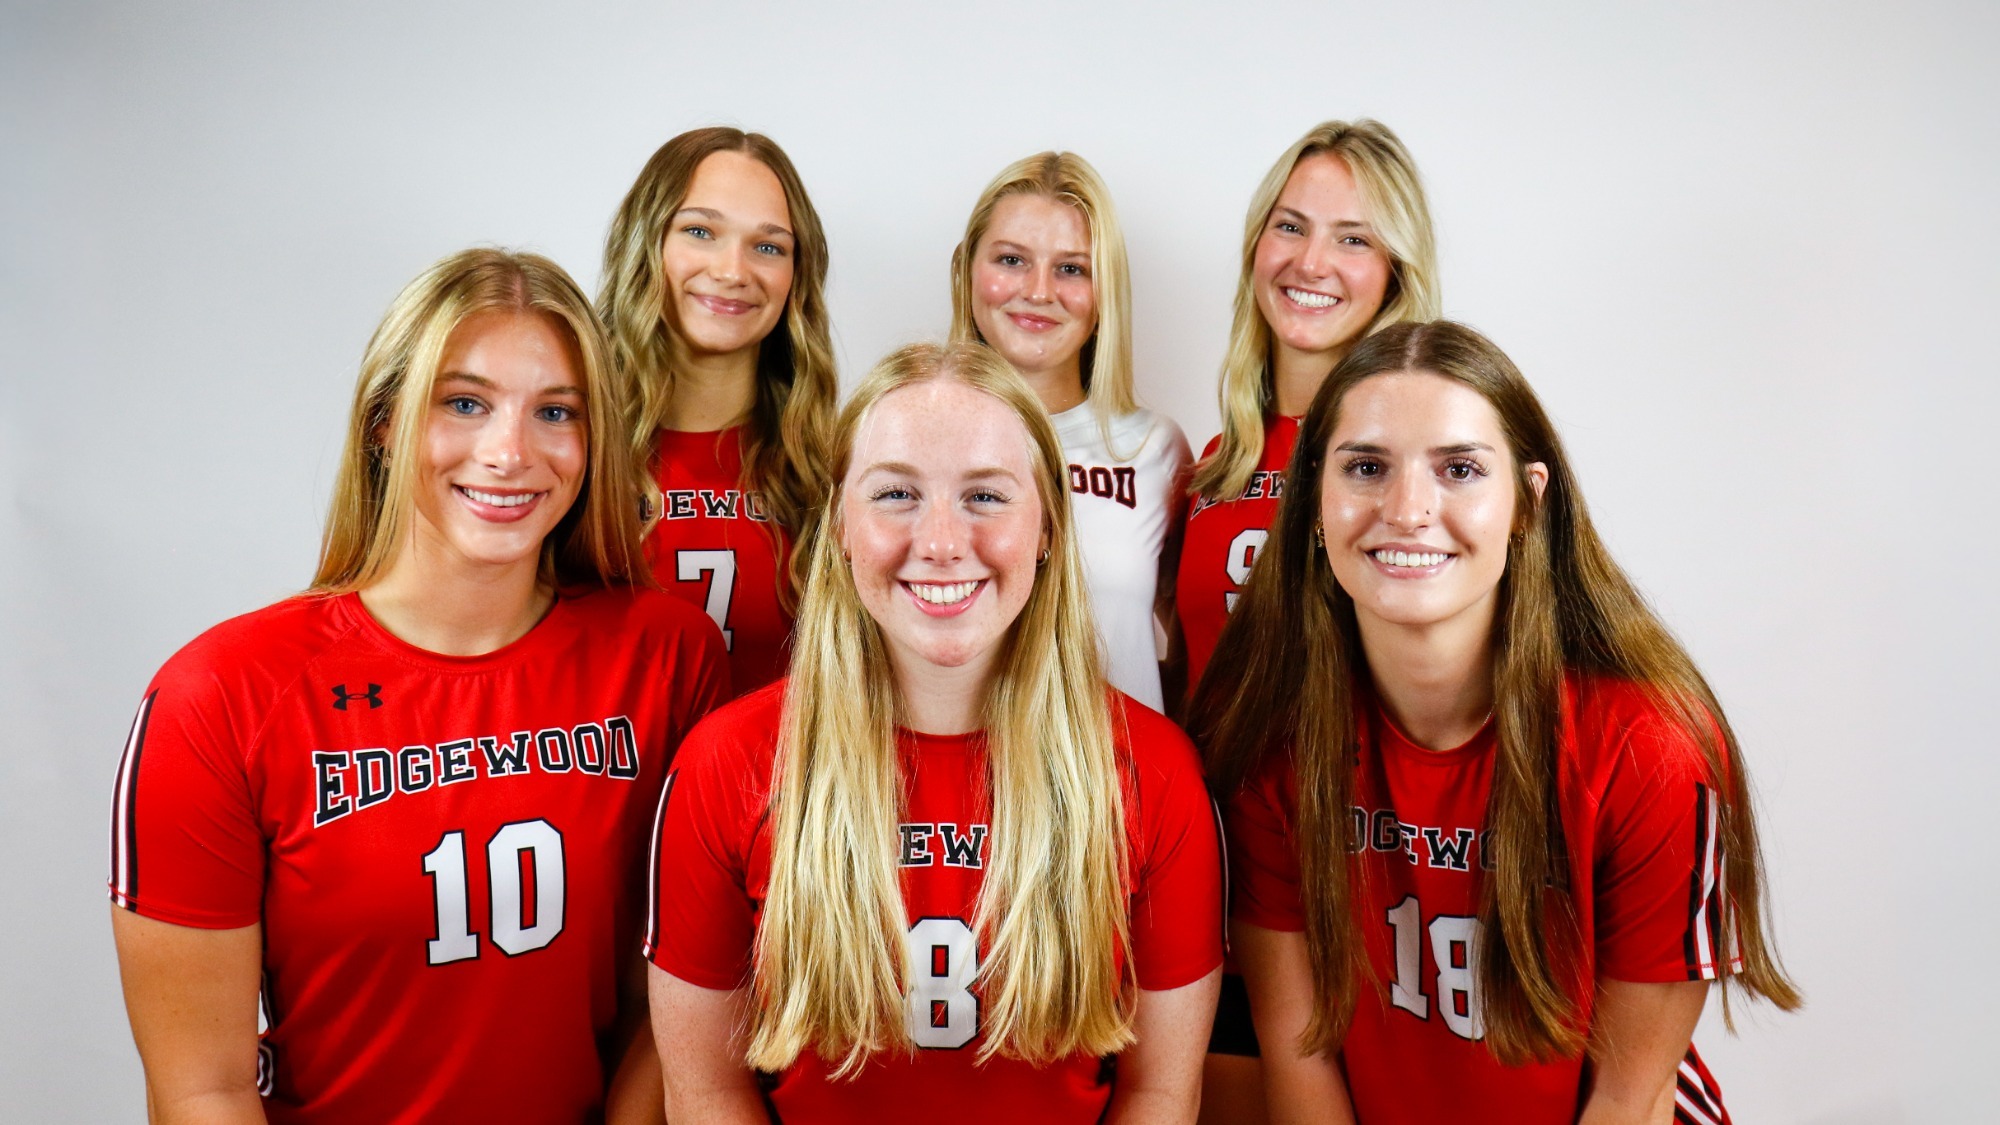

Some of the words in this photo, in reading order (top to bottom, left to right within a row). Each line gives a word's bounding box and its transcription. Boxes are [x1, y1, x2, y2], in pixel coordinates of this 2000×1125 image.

[637, 489, 786, 526] EWO
[675, 548, 738, 656] 7
[312, 715, 640, 829] EDGEWOOD
[421, 816, 567, 967] 10
[903, 915, 981, 1050] 8
[1385, 892, 1486, 1042] 18
